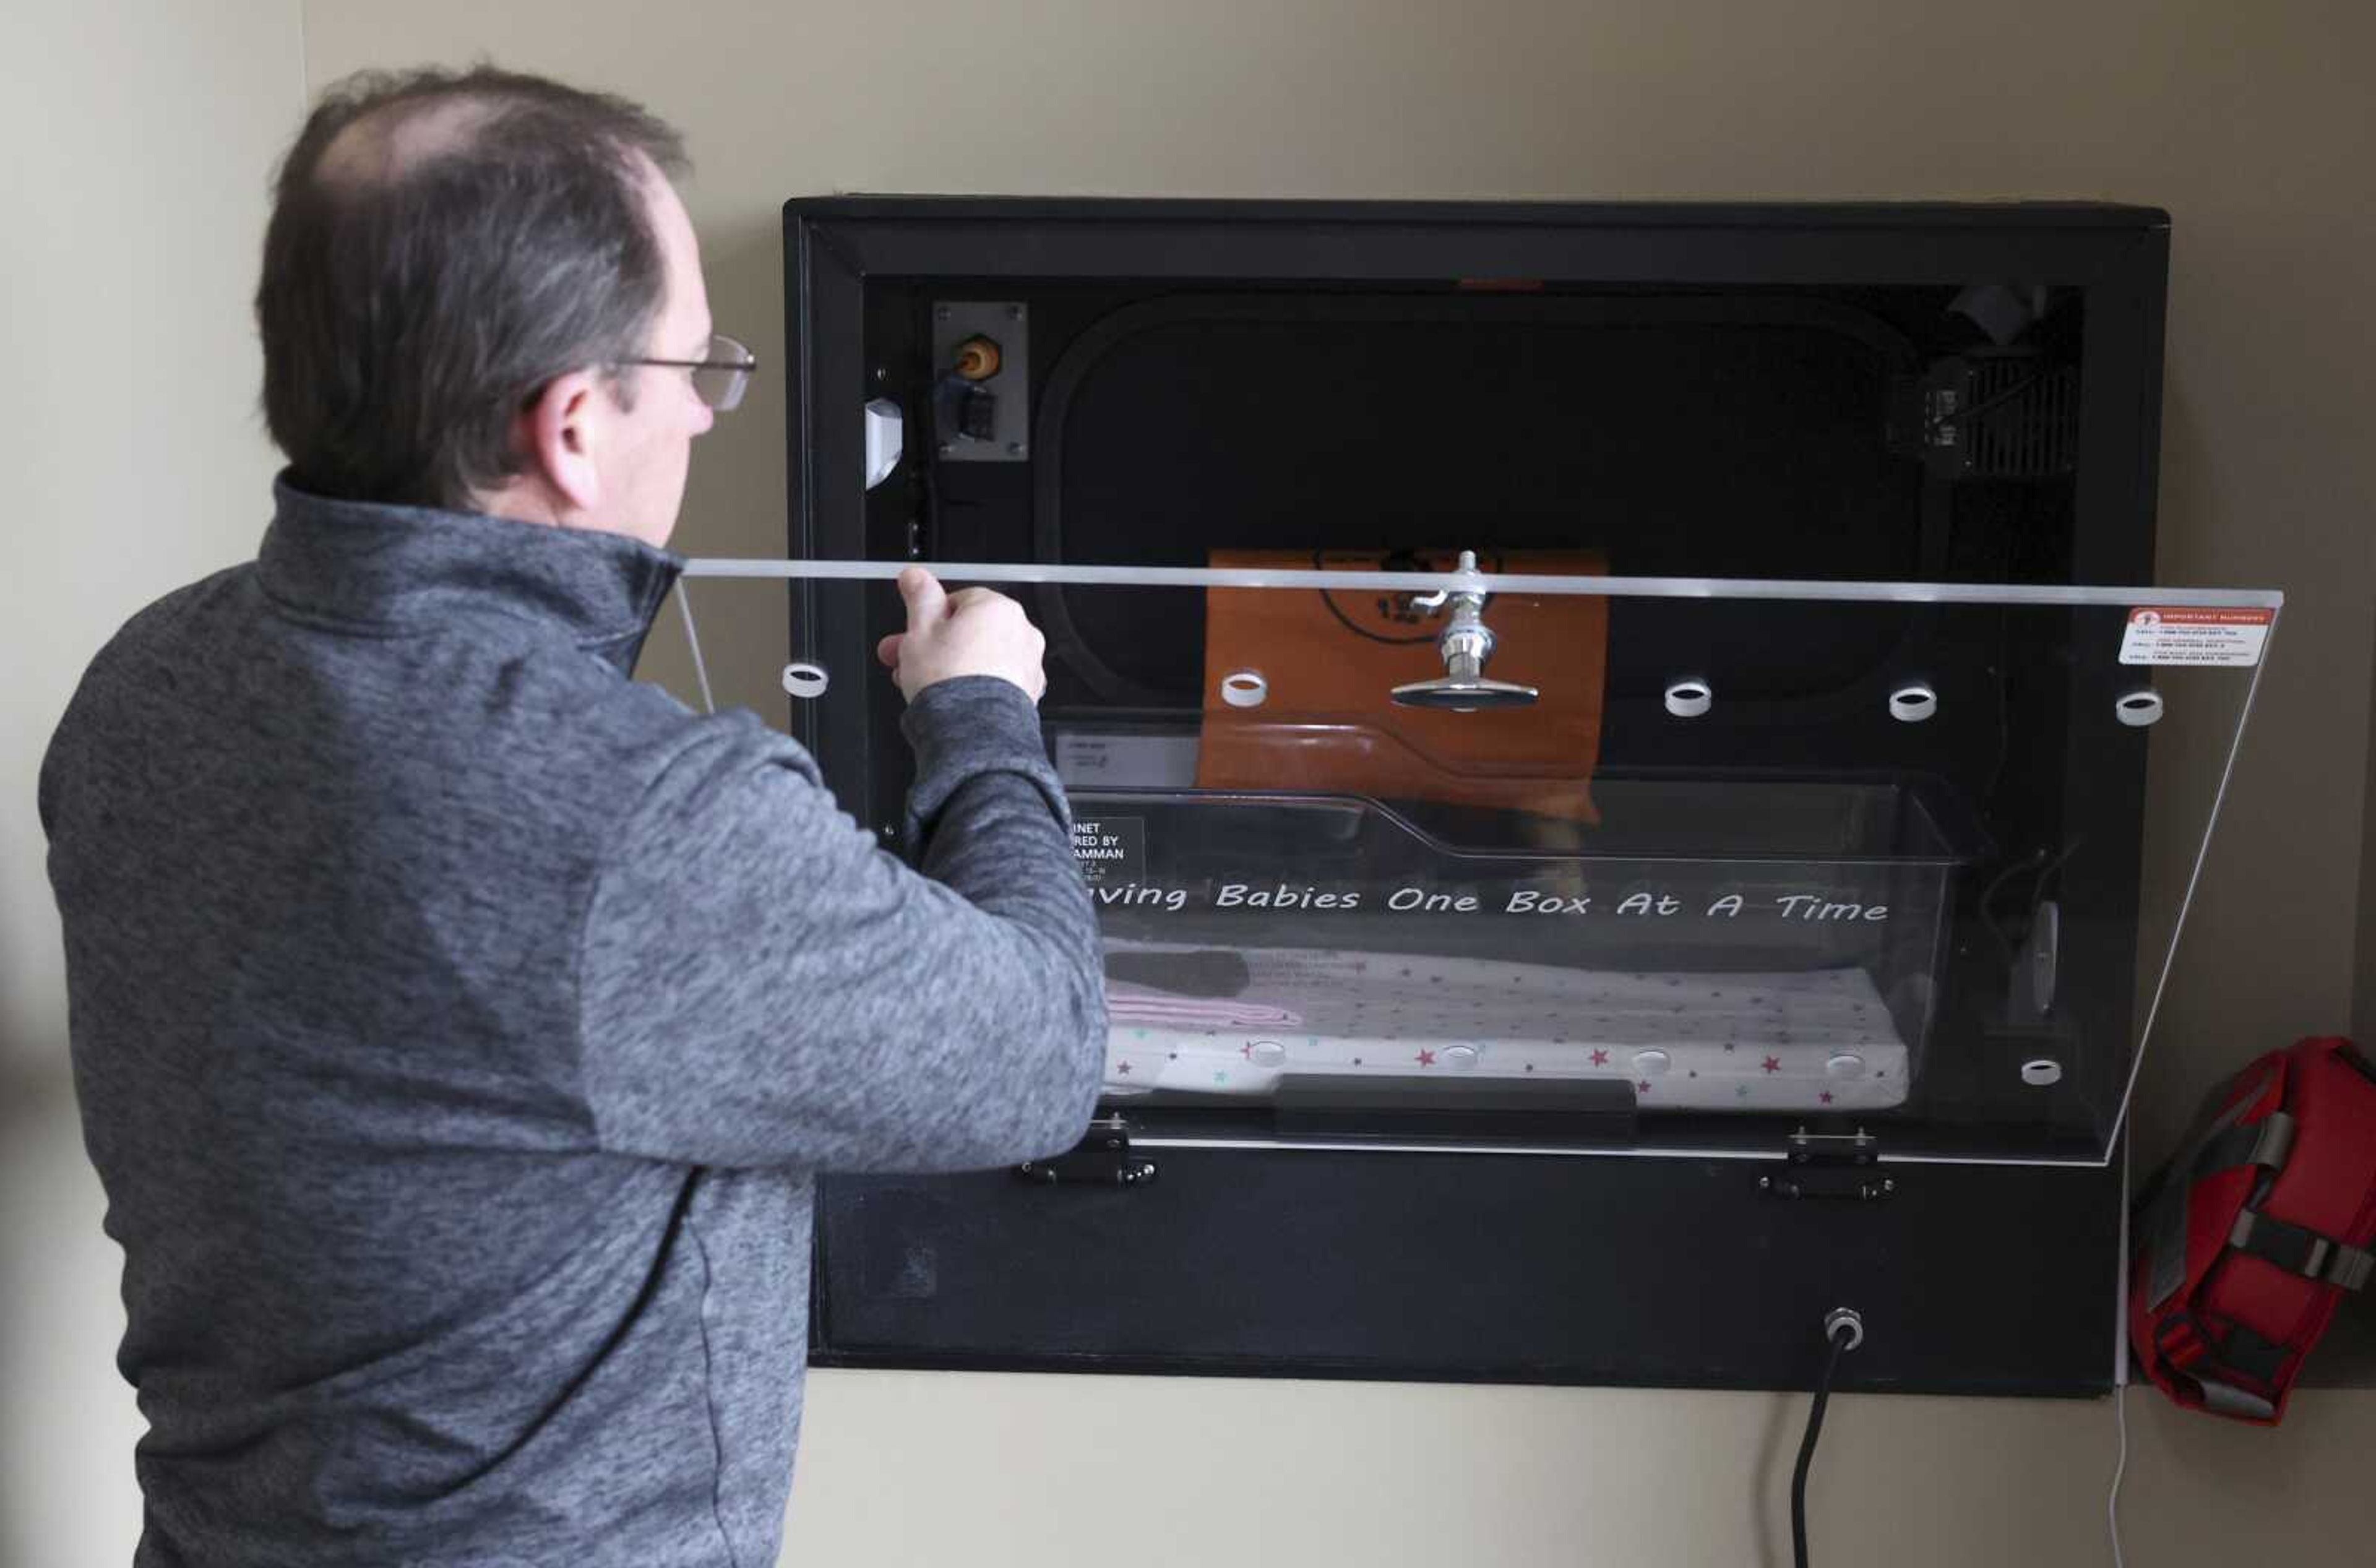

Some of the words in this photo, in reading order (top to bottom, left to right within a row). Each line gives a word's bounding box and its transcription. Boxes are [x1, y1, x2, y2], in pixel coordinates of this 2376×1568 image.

[1102, 835, 1119, 846] BY
[1215, 884, 1361, 909] Babies
[1388, 887, 1478, 911] One
[1505, 890, 1591, 914] Box
[1616, 892, 1681, 916] At
[1707, 894, 1744, 916] A
[1776, 895, 1888, 921] Time
